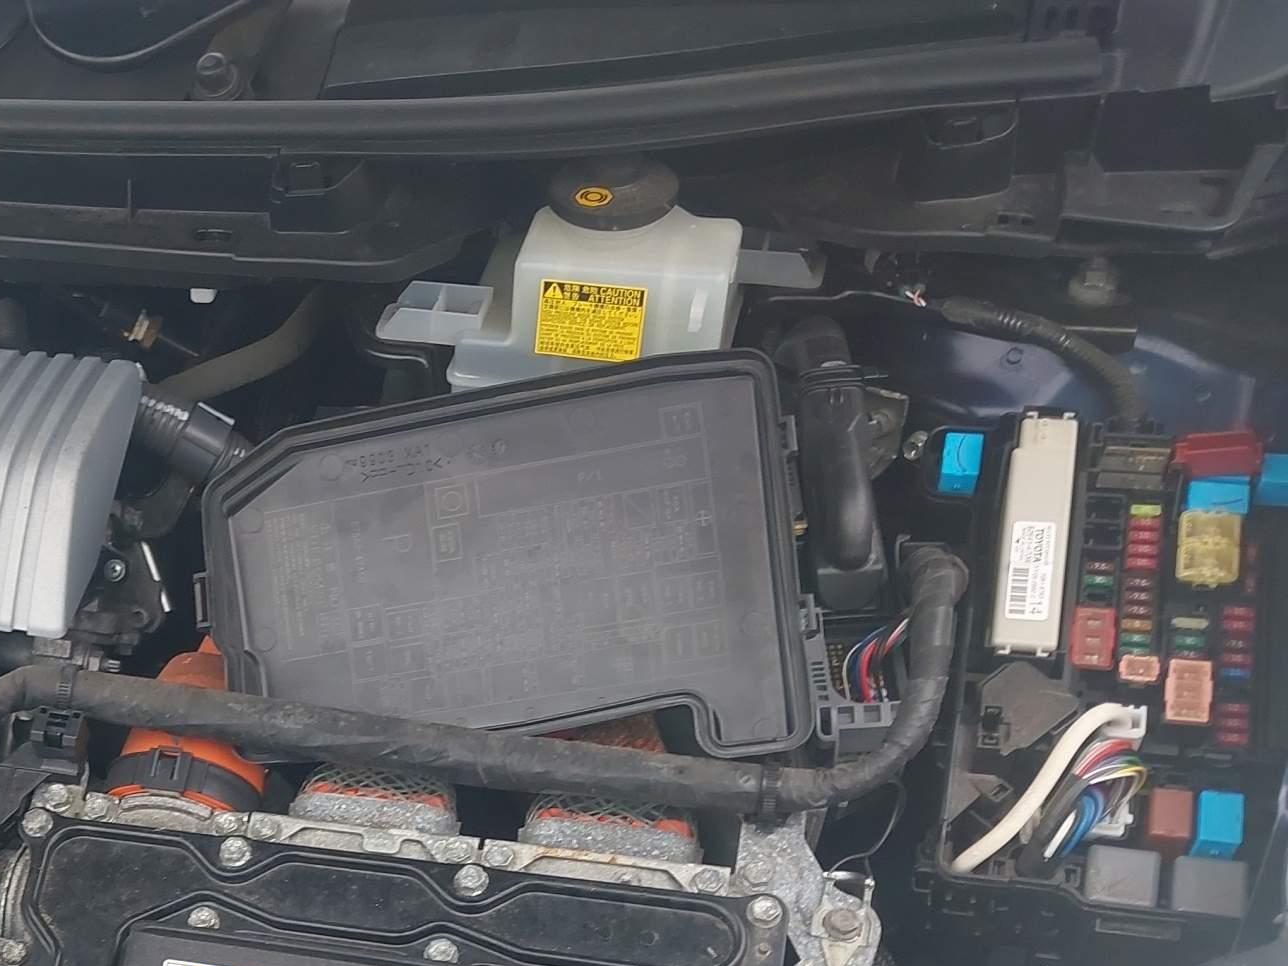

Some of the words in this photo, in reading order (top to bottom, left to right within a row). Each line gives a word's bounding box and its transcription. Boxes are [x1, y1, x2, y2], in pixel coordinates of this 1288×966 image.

[599, 287, 642, 299] CAUTION
[588, 295, 640, 307] ATTENTION
[1031, 527, 1045, 563] TOYOTA
